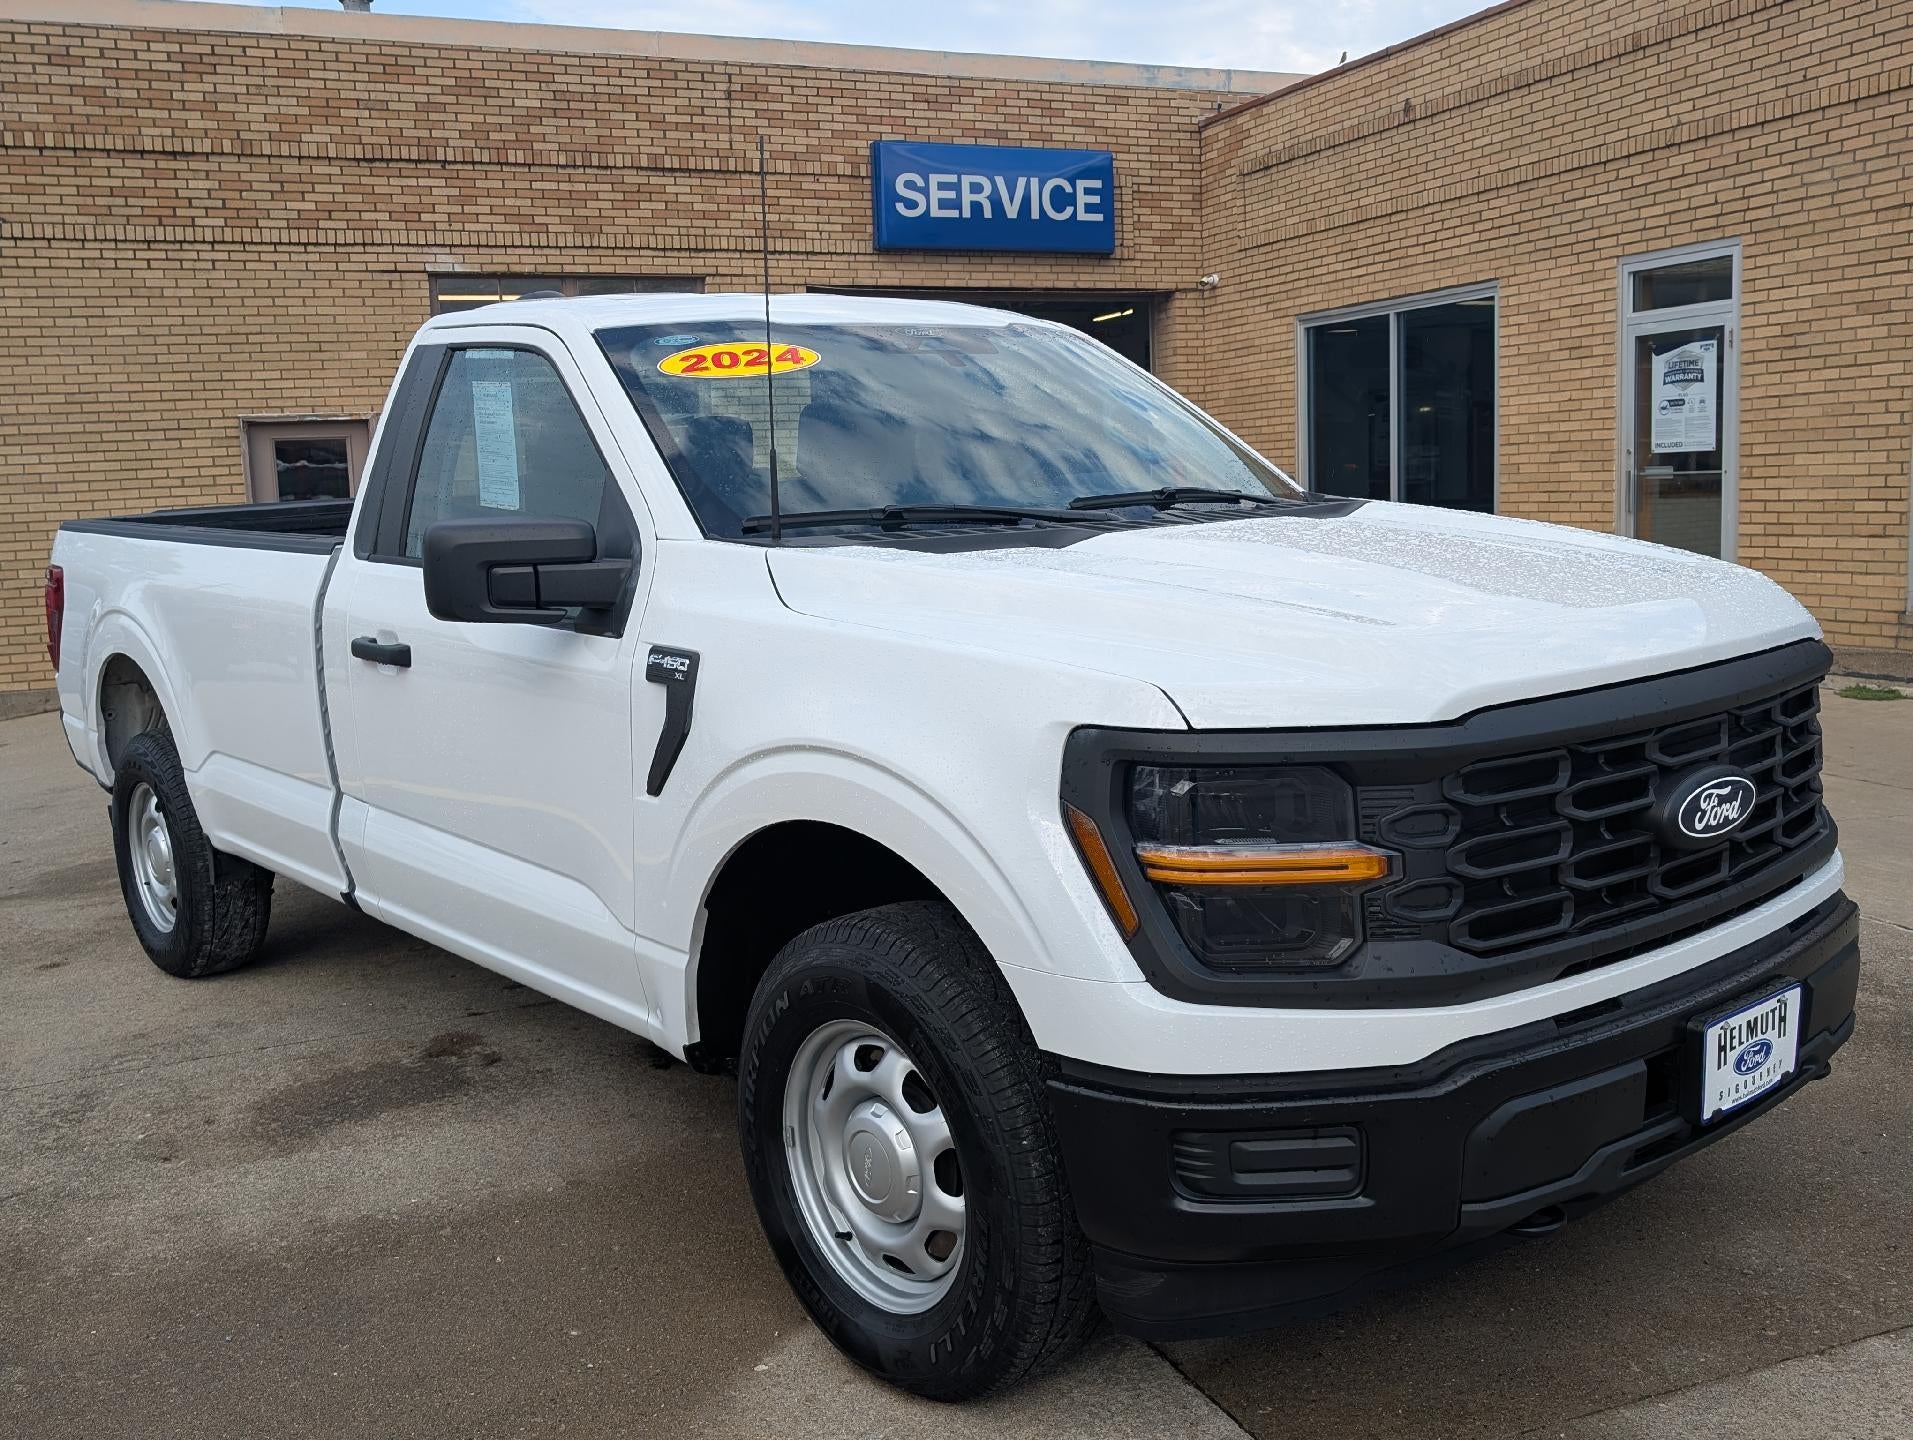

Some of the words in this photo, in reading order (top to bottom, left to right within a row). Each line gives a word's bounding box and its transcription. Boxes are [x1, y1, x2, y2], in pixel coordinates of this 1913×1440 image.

[895, 172, 1104, 222] SERVICE
[679, 346, 807, 375] 2024
[1668, 359, 1699, 369] LIFETIME
[1664, 372, 1702, 383] WARRANTY
[1654, 441, 1683, 449] INCLUDED
[648, 654, 690, 671] F-150
[674, 672, 685, 681] XL
[1694, 785, 1743, 831] Ford
[1717, 998, 1788, 1071] HELMUTH
[1740, 1044, 1767, 1072] Ford
[1718, 1059, 1783, 1101] SIGOURNEY
